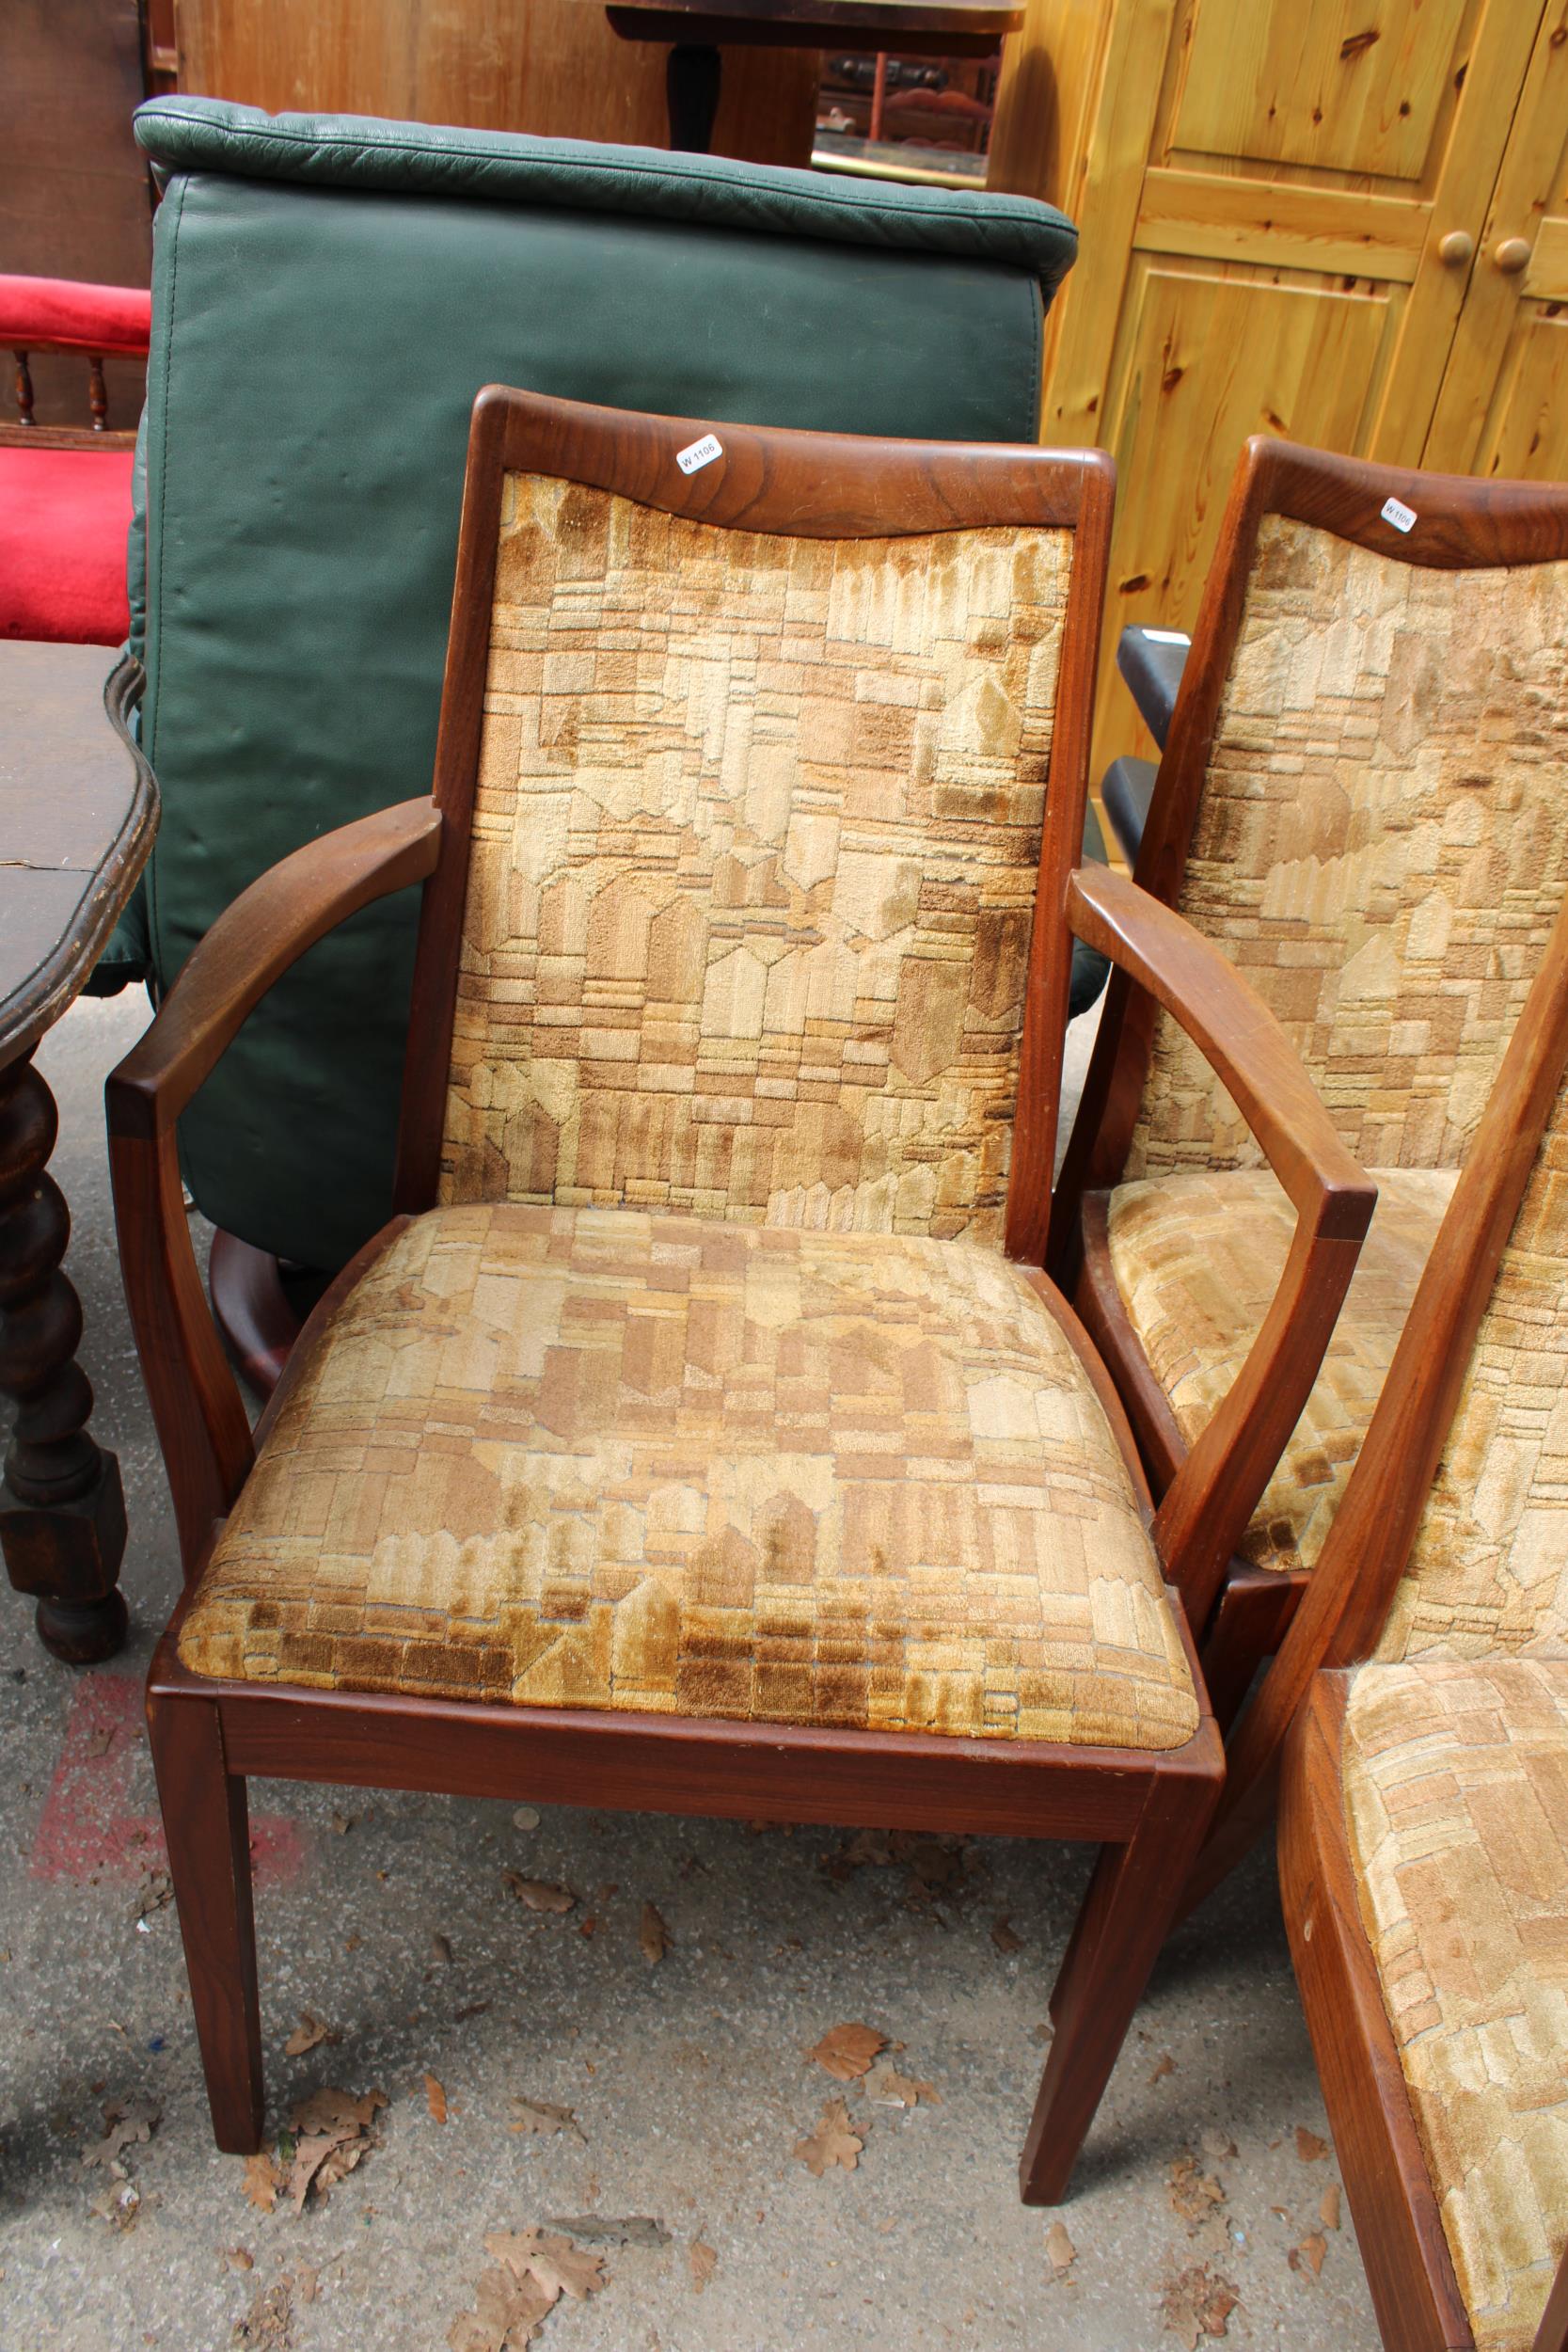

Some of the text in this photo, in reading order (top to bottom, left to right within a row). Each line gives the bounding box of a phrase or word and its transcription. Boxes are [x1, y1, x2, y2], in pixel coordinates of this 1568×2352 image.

[682, 443, 715, 467] W 1106
[1386, 503, 1411, 526] W 1106
